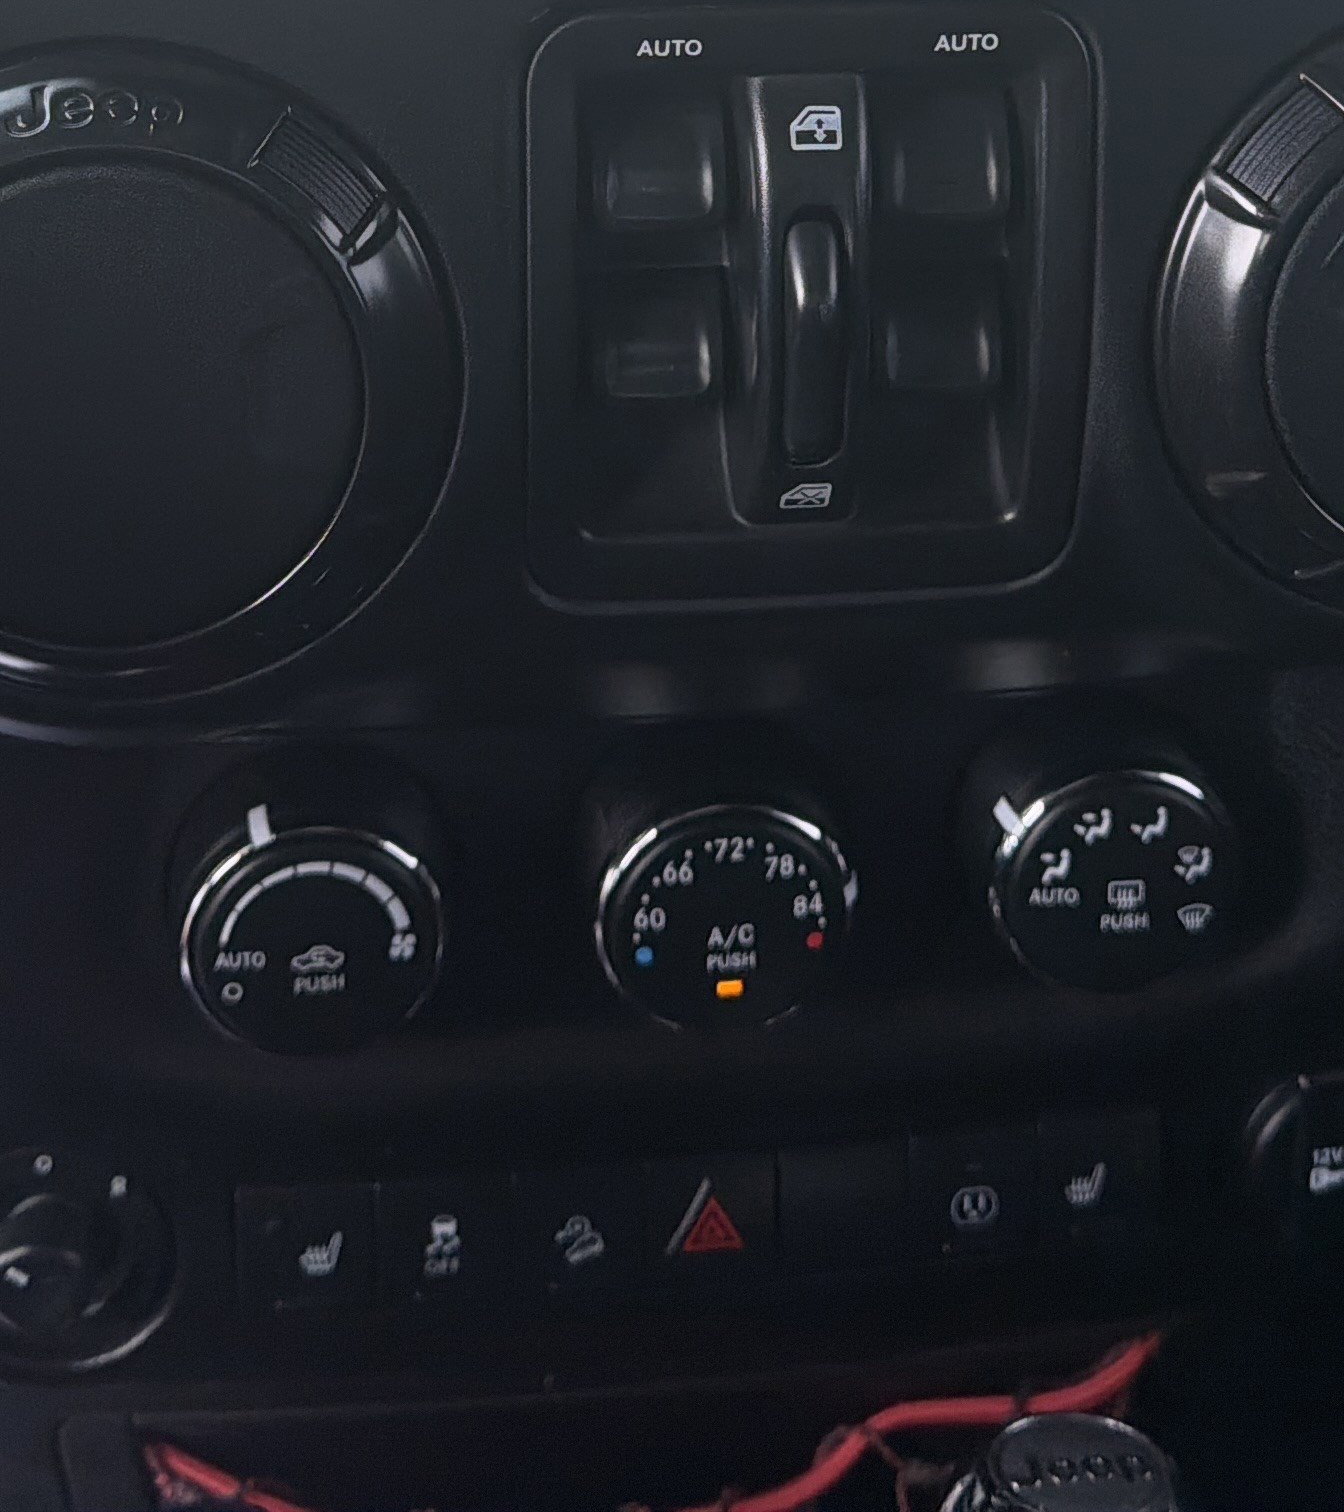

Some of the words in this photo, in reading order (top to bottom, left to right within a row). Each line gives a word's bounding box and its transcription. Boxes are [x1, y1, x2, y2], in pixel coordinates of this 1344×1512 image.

[636, 39, 703, 57] AUTO
[934, 33, 999, 52] AUTO
[6, 85, 184, 138] Jeep
[714, 836, 745, 863] 72
[662, 860, 694, 886] 66
[765, 853, 795, 881] 78
[793, 891, 824, 919] 84
[1028, 887, 1080, 905] AUTO
[633, 907, 666, 931] 60
[1099, 912, 1149, 931] PUSH
[707, 923, 755, 951] A/C
[214, 951, 266, 971] AUTO
[706, 952, 757, 973] PUSH
[293, 973, 346, 994] PUSH
